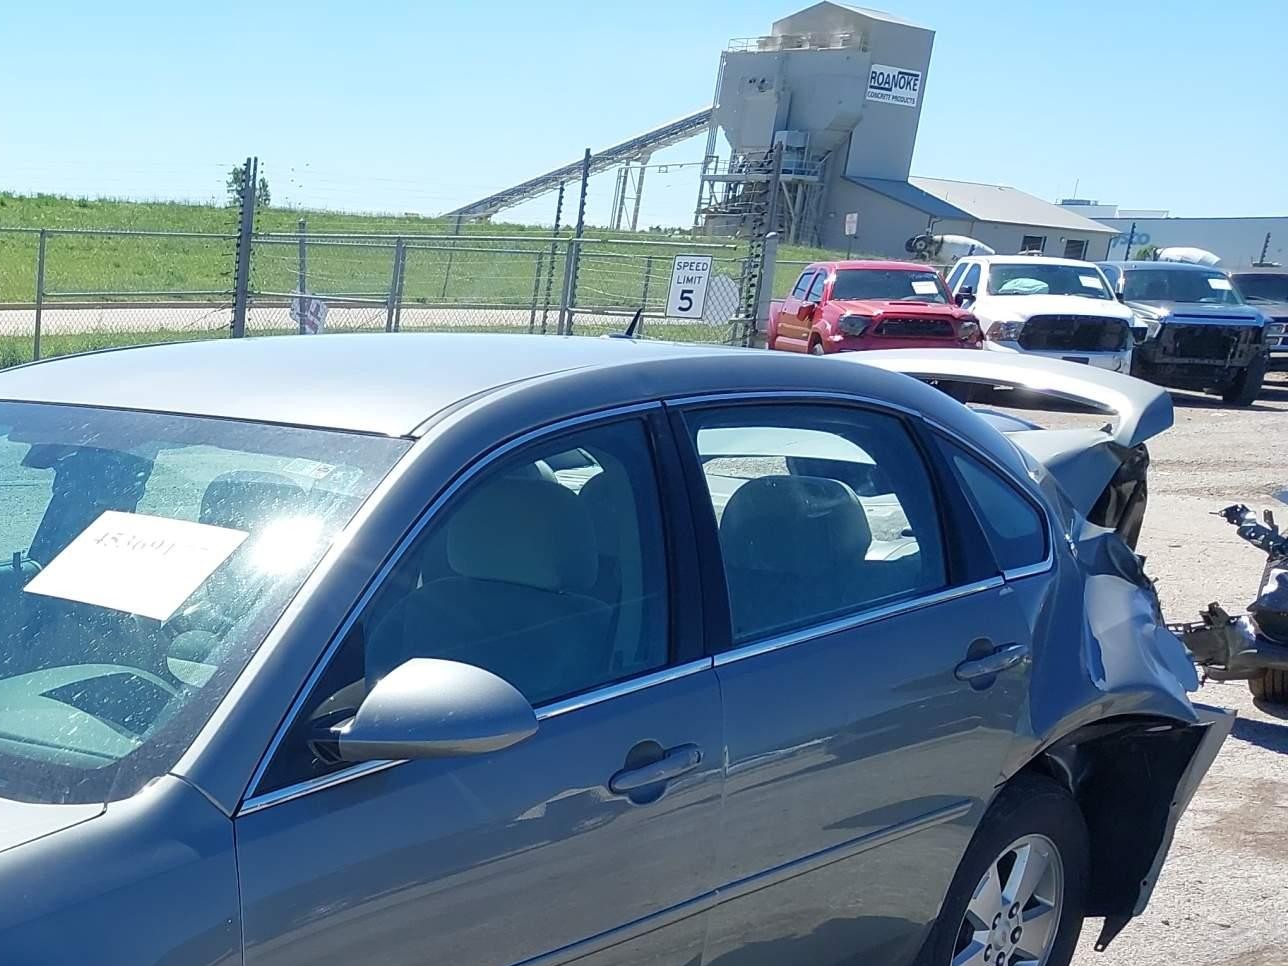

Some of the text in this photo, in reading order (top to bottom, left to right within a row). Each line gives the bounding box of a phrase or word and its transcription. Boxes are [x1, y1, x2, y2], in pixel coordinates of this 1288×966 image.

[870, 71, 919, 91] ROANOKE
[868, 92, 915, 104] CONCRETE PRODUCTS
[676, 261, 708, 271] SPEED
[676, 275, 703, 284] LIMIT
[677, 289, 694, 312] 5
